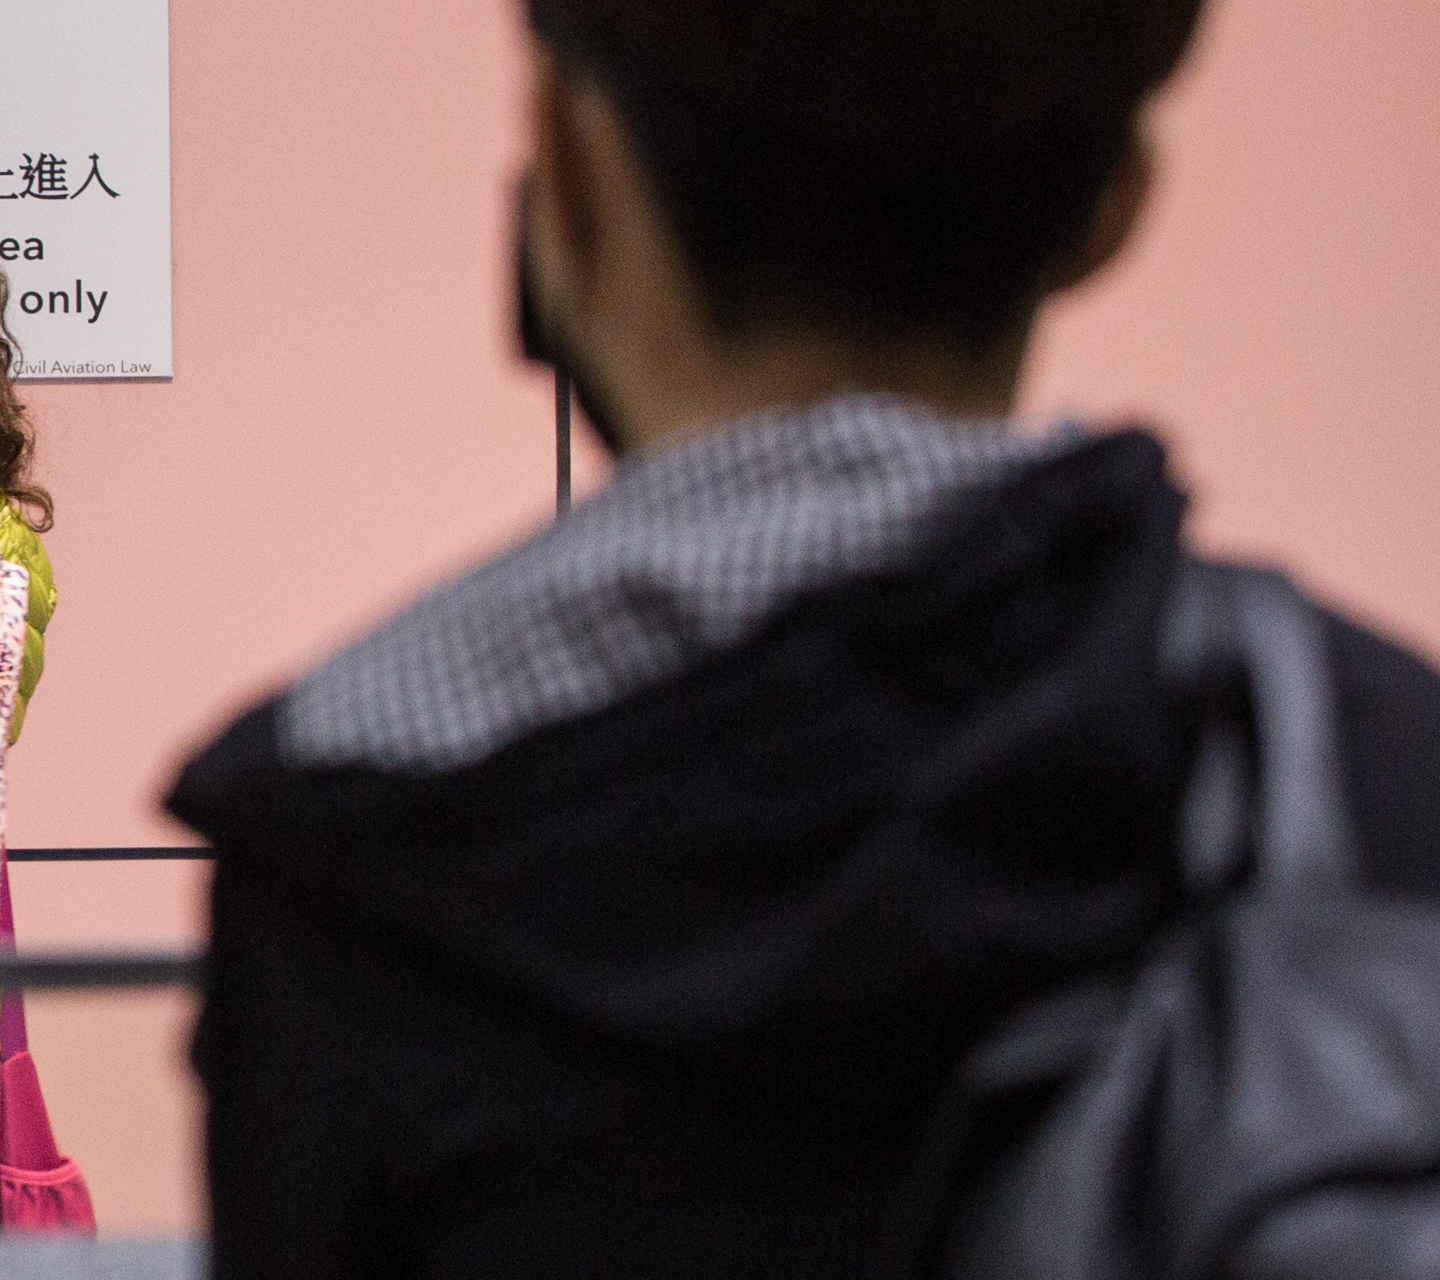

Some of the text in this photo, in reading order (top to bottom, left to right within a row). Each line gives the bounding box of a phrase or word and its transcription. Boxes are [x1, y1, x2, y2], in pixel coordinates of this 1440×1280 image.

[20, 278, 108, 324] only
[50, 359, 115, 375] Aviation
[120, 359, 152, 373] Law
